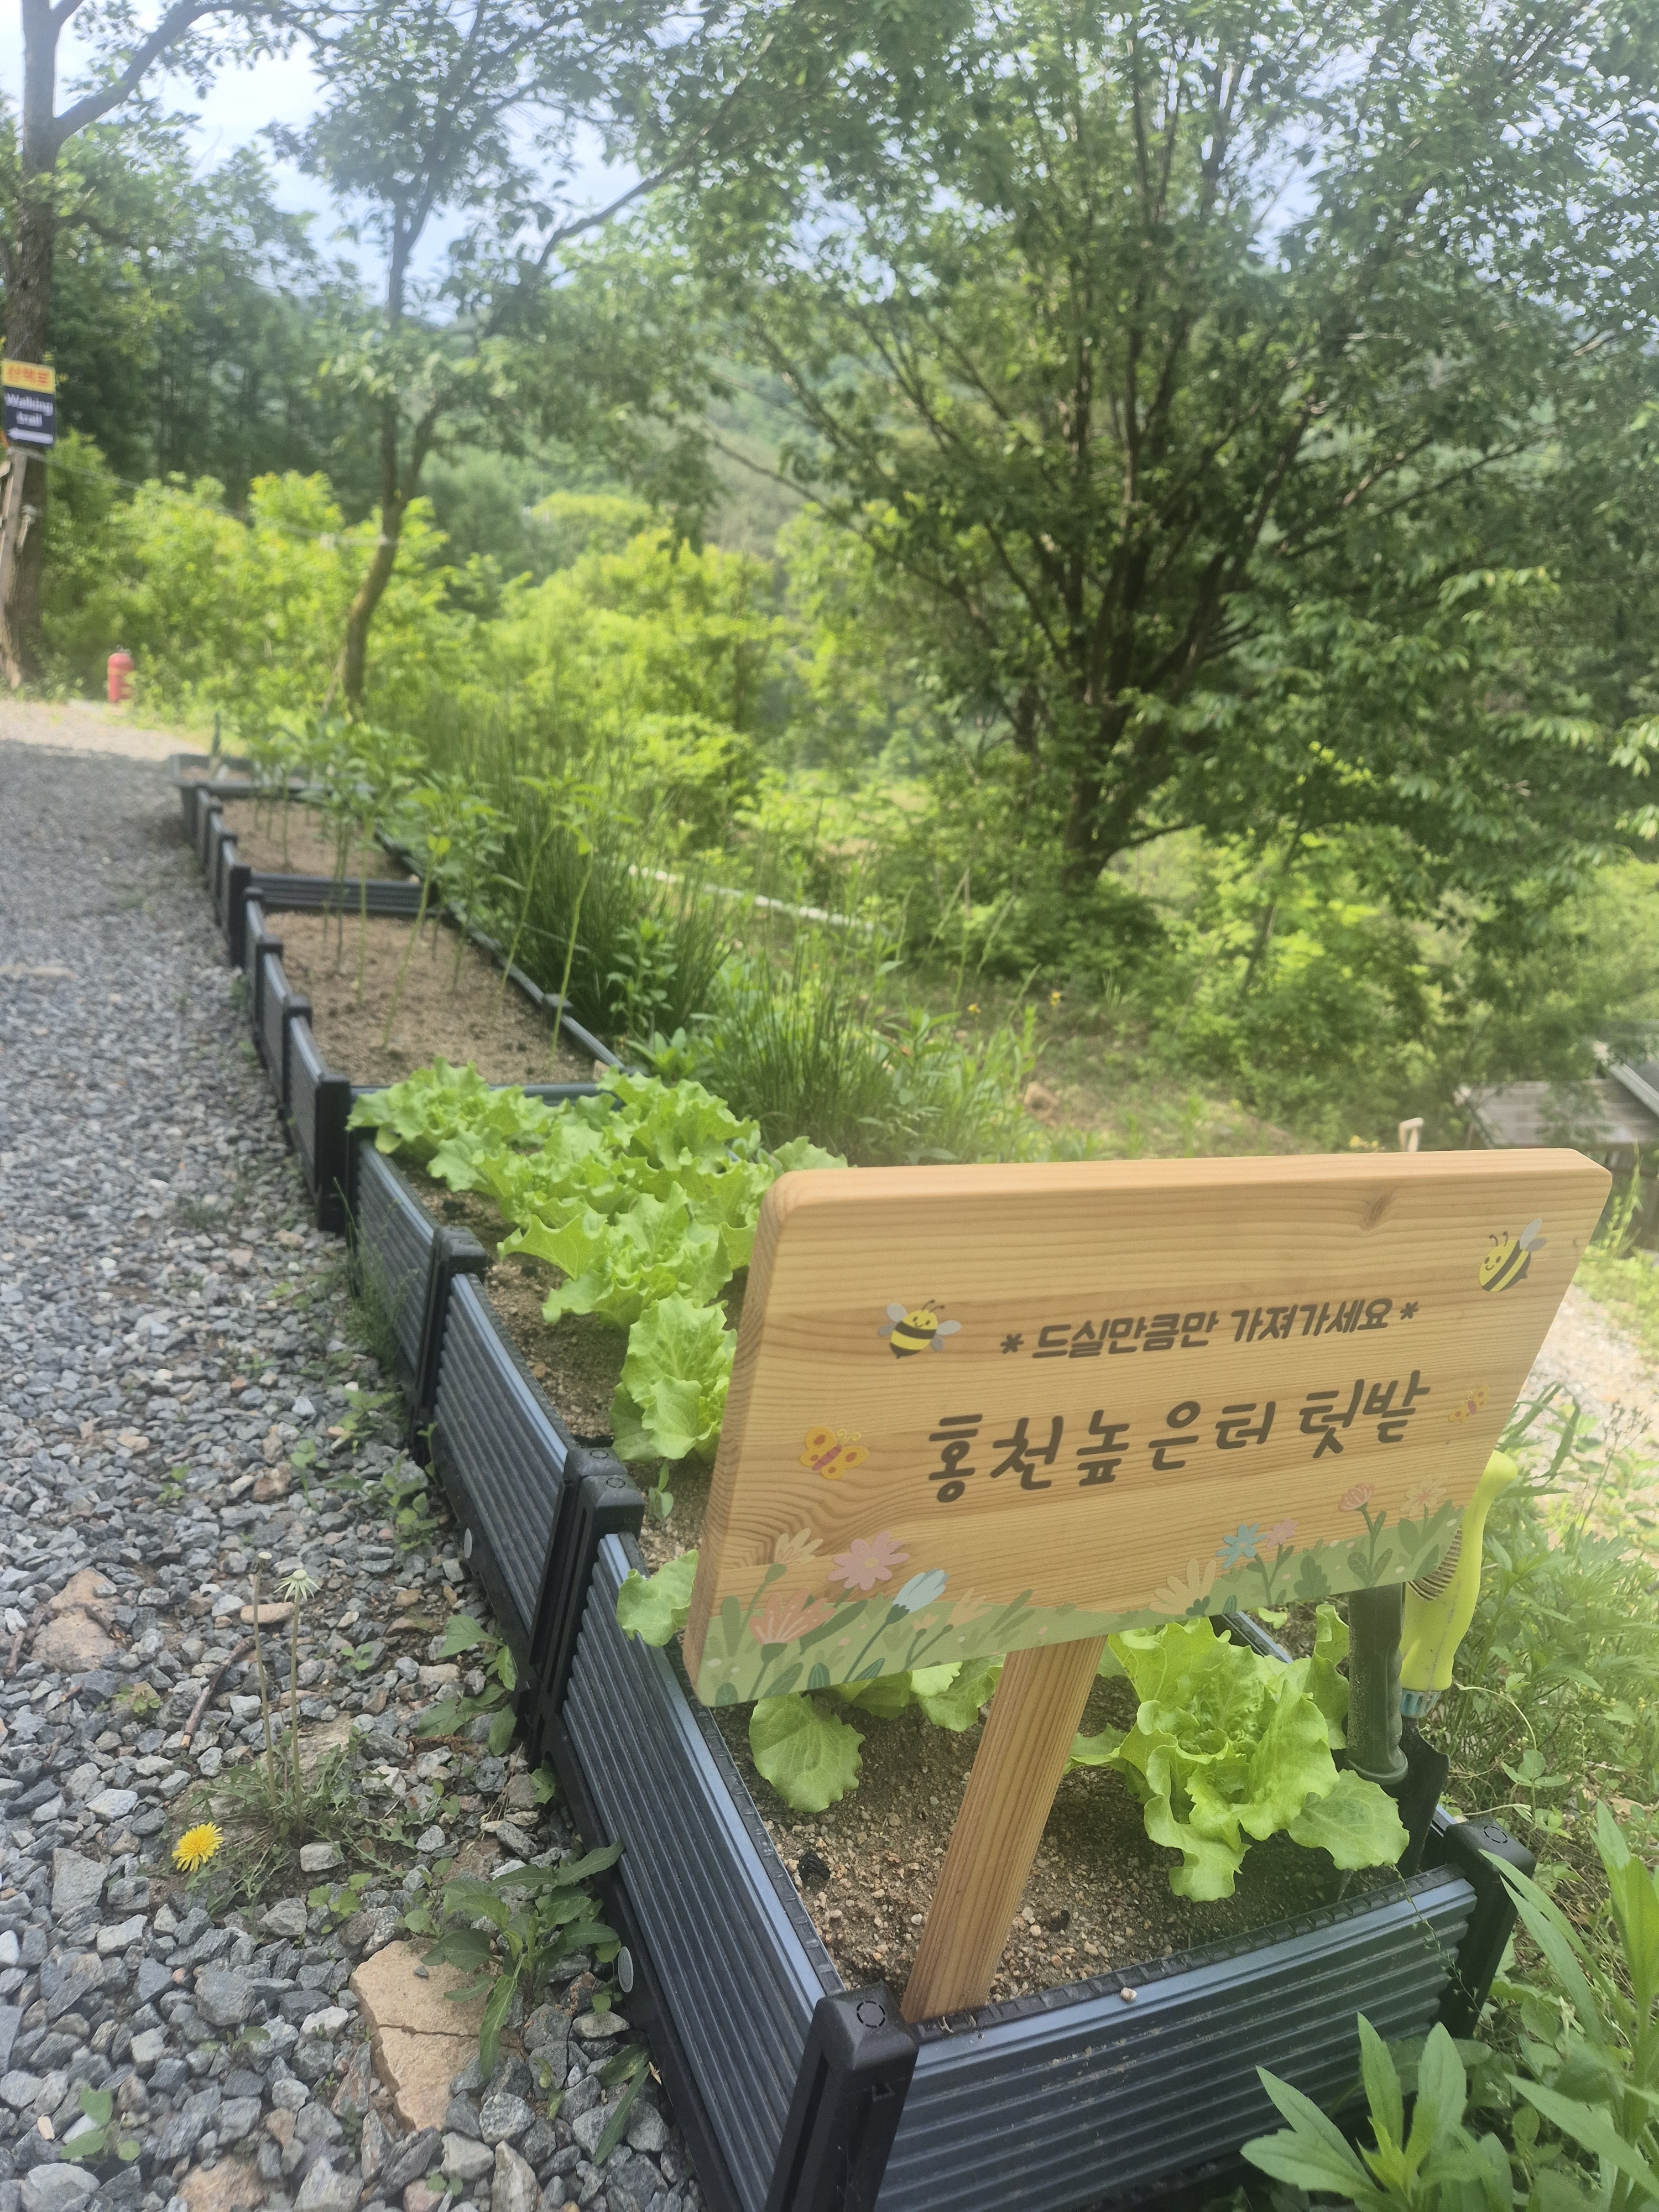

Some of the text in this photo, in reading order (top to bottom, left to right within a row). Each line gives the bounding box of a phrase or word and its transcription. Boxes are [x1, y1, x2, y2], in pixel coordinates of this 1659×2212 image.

[5, 393, 53, 416] Walking
[15, 411, 43, 427] trail
[1031, 1298, 1393, 1358] 드실만큼만 가져가세요
[1299, 1369, 1430, 1459] 텃밭
